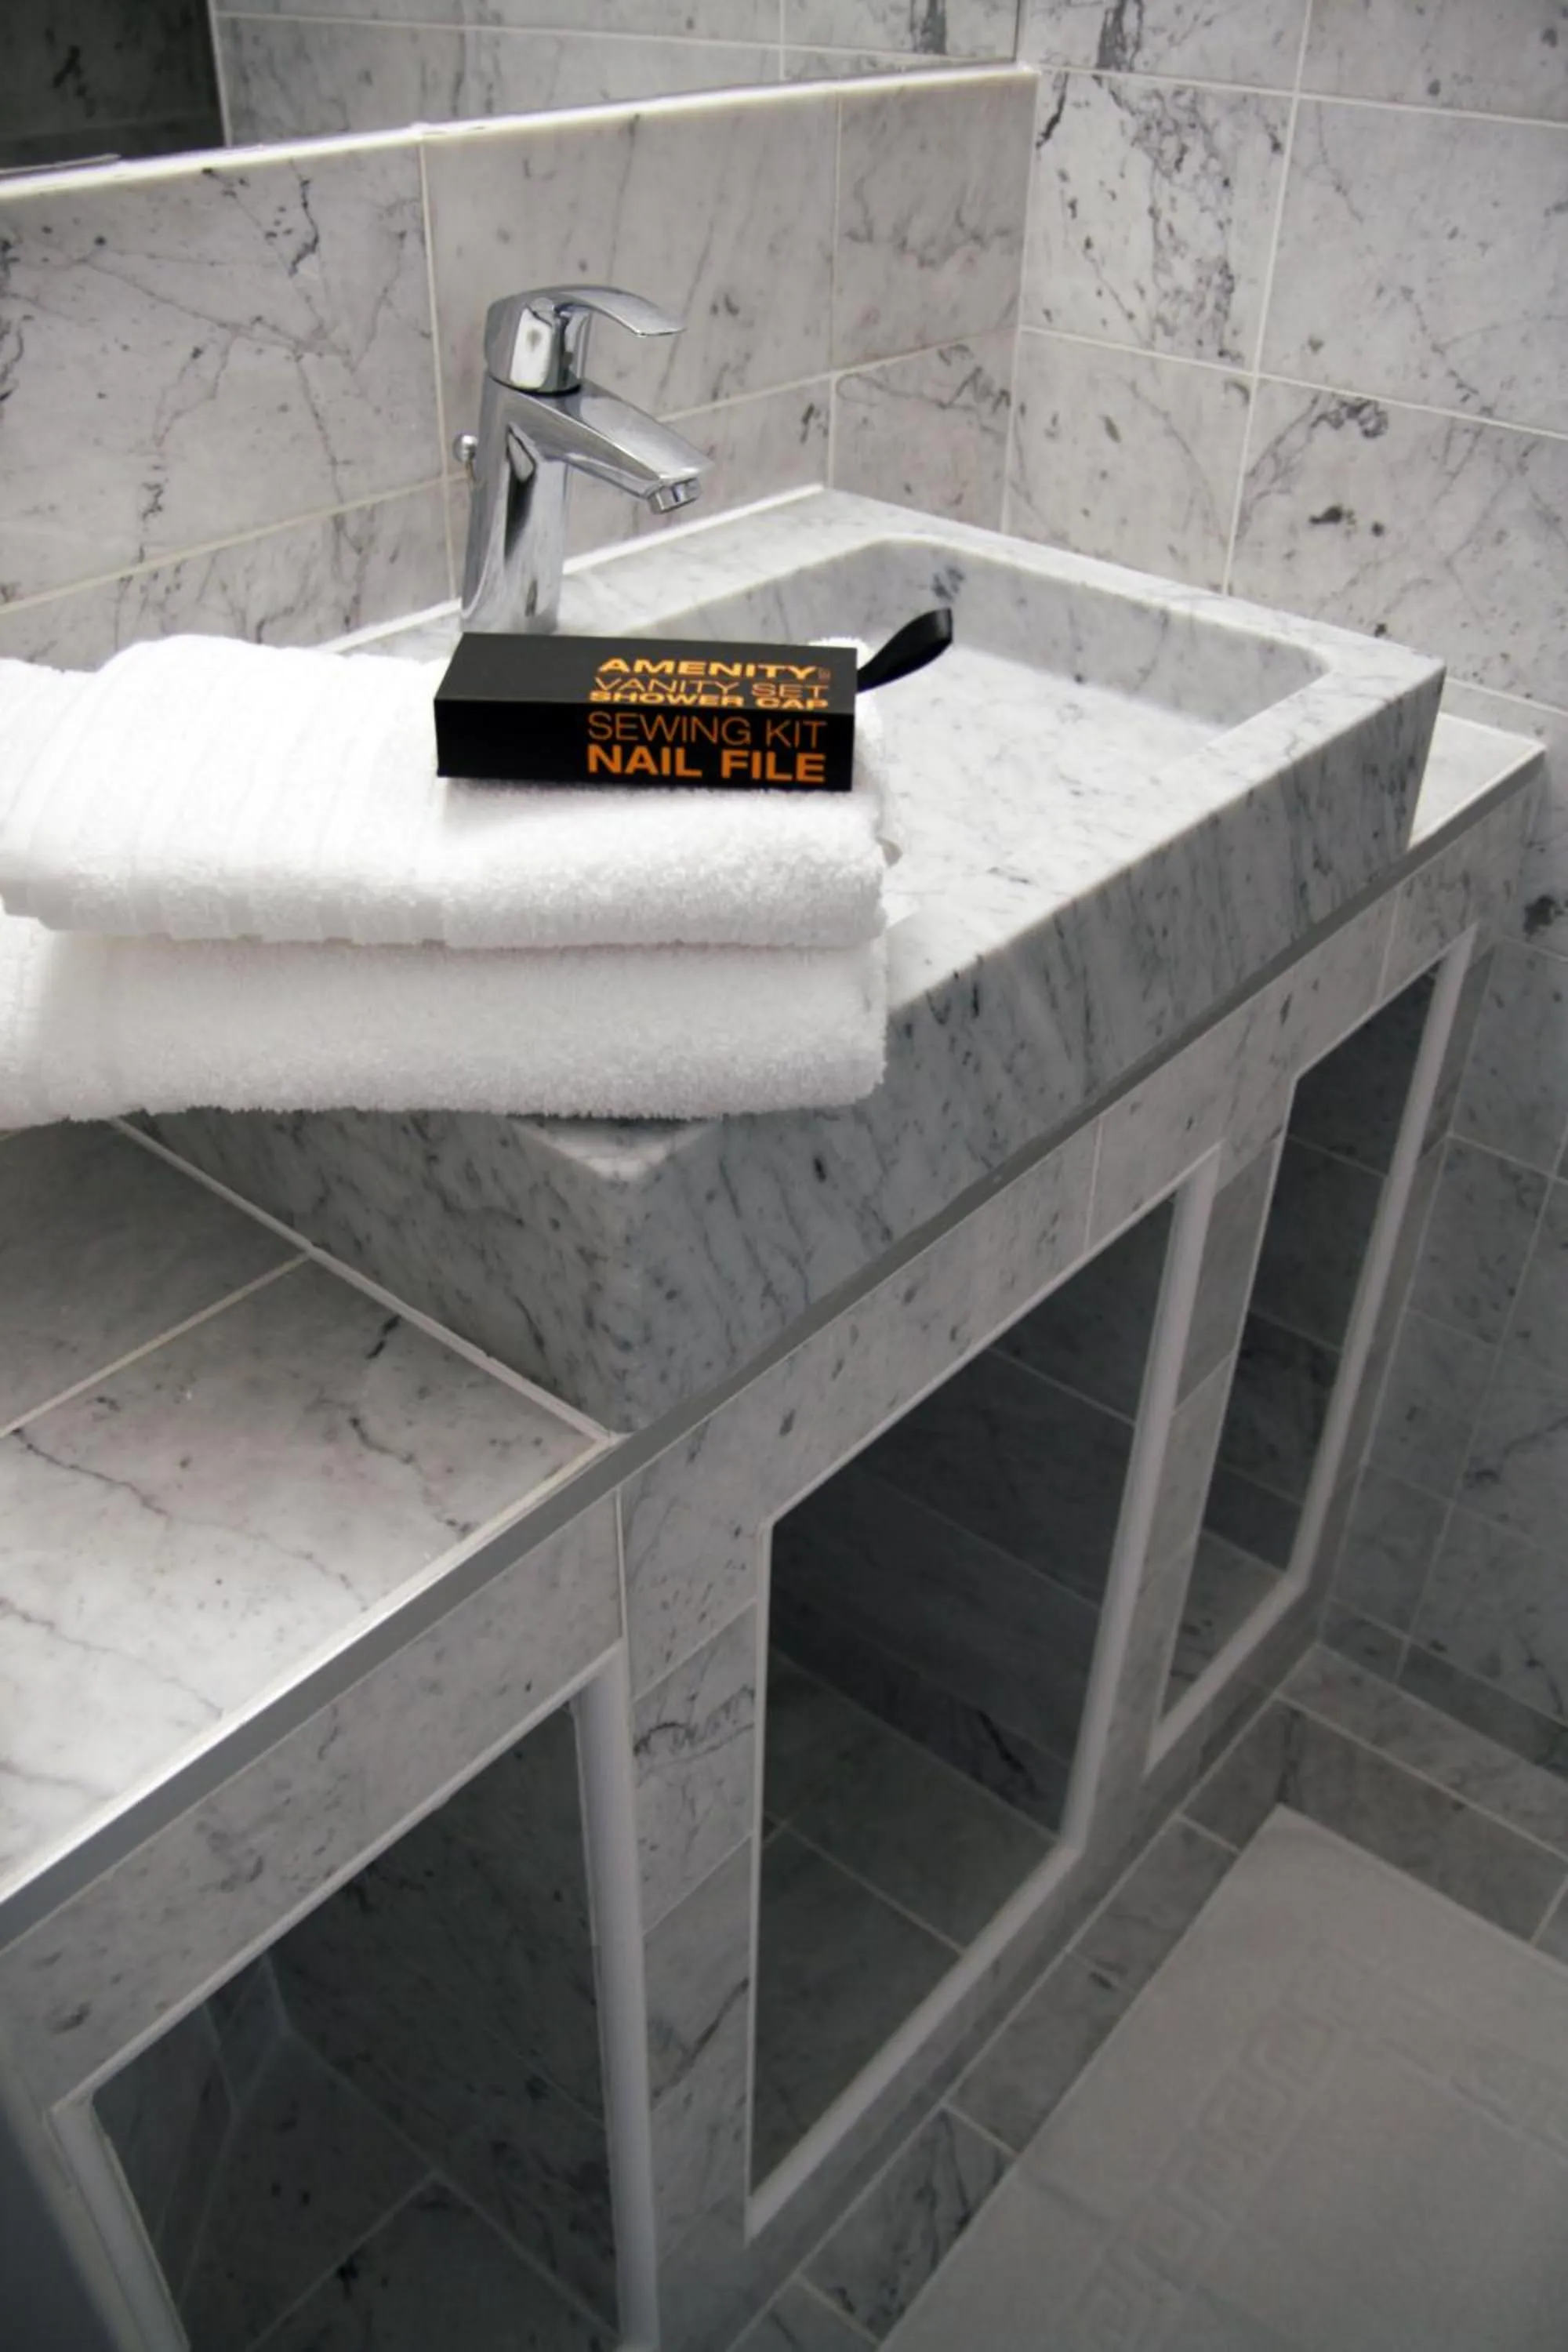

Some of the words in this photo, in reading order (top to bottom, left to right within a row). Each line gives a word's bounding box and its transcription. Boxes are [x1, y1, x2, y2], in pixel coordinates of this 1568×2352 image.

[599, 658, 816, 680] AMENITY
[594, 677, 740, 693] VANITY
[751, 682, 829, 698] SET
[589, 690, 744, 706] SHOWER
[755, 698, 829, 710] CAP
[588, 711, 750, 745] SEWING
[765, 719, 828, 748] KIT
[587, 744, 702, 778] NAIL
[720, 750, 826, 782] FILE
